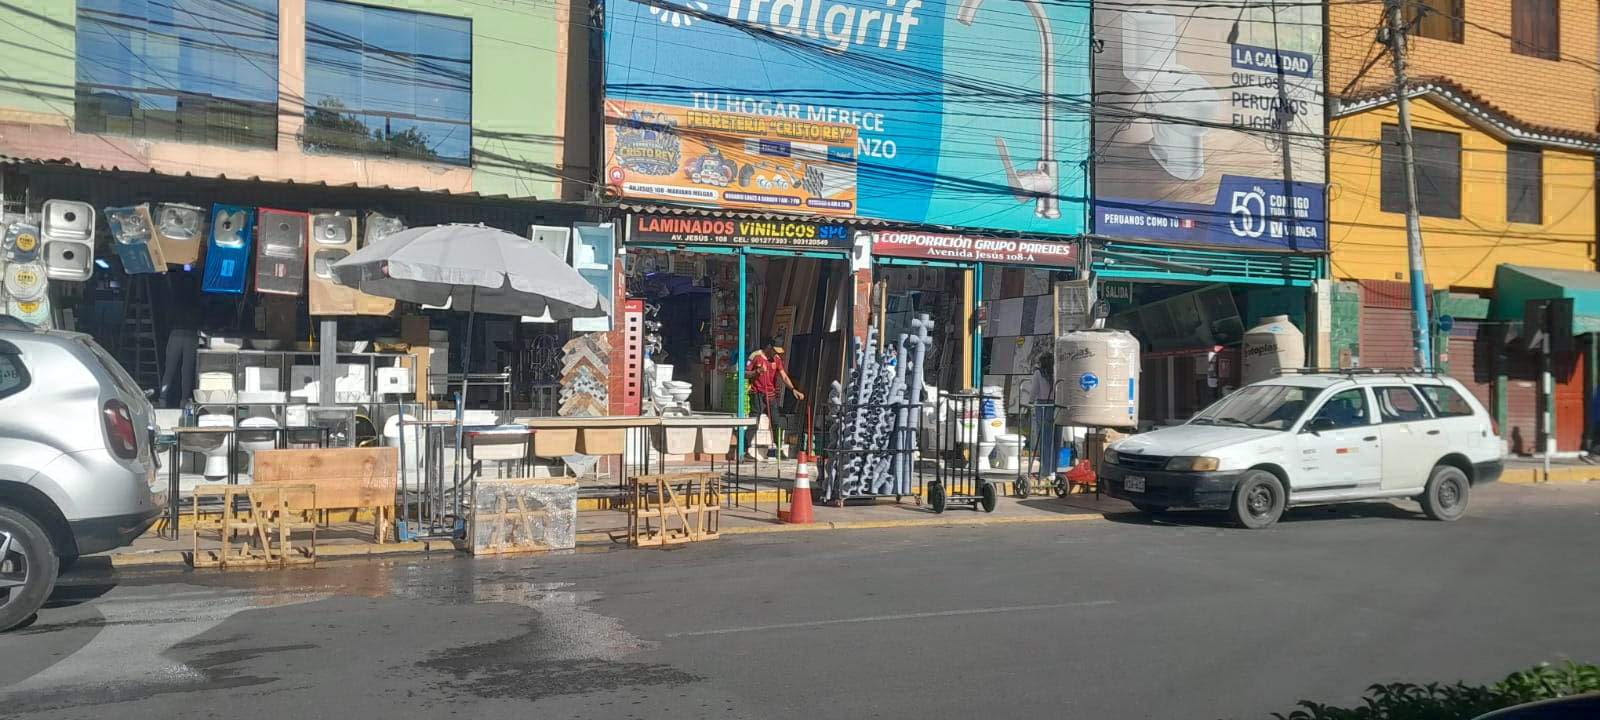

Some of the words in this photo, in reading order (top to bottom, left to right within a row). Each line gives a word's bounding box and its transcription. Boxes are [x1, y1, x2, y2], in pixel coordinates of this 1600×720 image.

[1236, 48, 1253, 65] LA
[1255, 52, 1309, 73] CALDAD
[1232, 72, 1255, 86] QUE
[1258, 76, 1280, 90] LOS
[691, 92, 718, 110] TU
[726, 94, 800, 119] HOGAR
[807, 105, 884, 132] MERECE
[1232, 92, 1308, 116] PERUANOS
[858, 137, 897, 159] NZO
[1104, 213, 1144, 226] PERUANOS
[1146, 216, 1168, 227] COMO
[1230, 191, 1265, 238] 50
[638, 218, 734, 236] LAMINADOS
[1284, 225, 1317, 238] VINSA
[881, 232, 972, 249] CORPORACIÓN
[975, 239, 1017, 251] GRUPO
[1018, 243, 1070, 256] PAREDES
[928, 247, 972, 258] Avenida
[1006, 253, 1035, 262] 108-A
[1104, 284, 1129, 299] SALIDA
